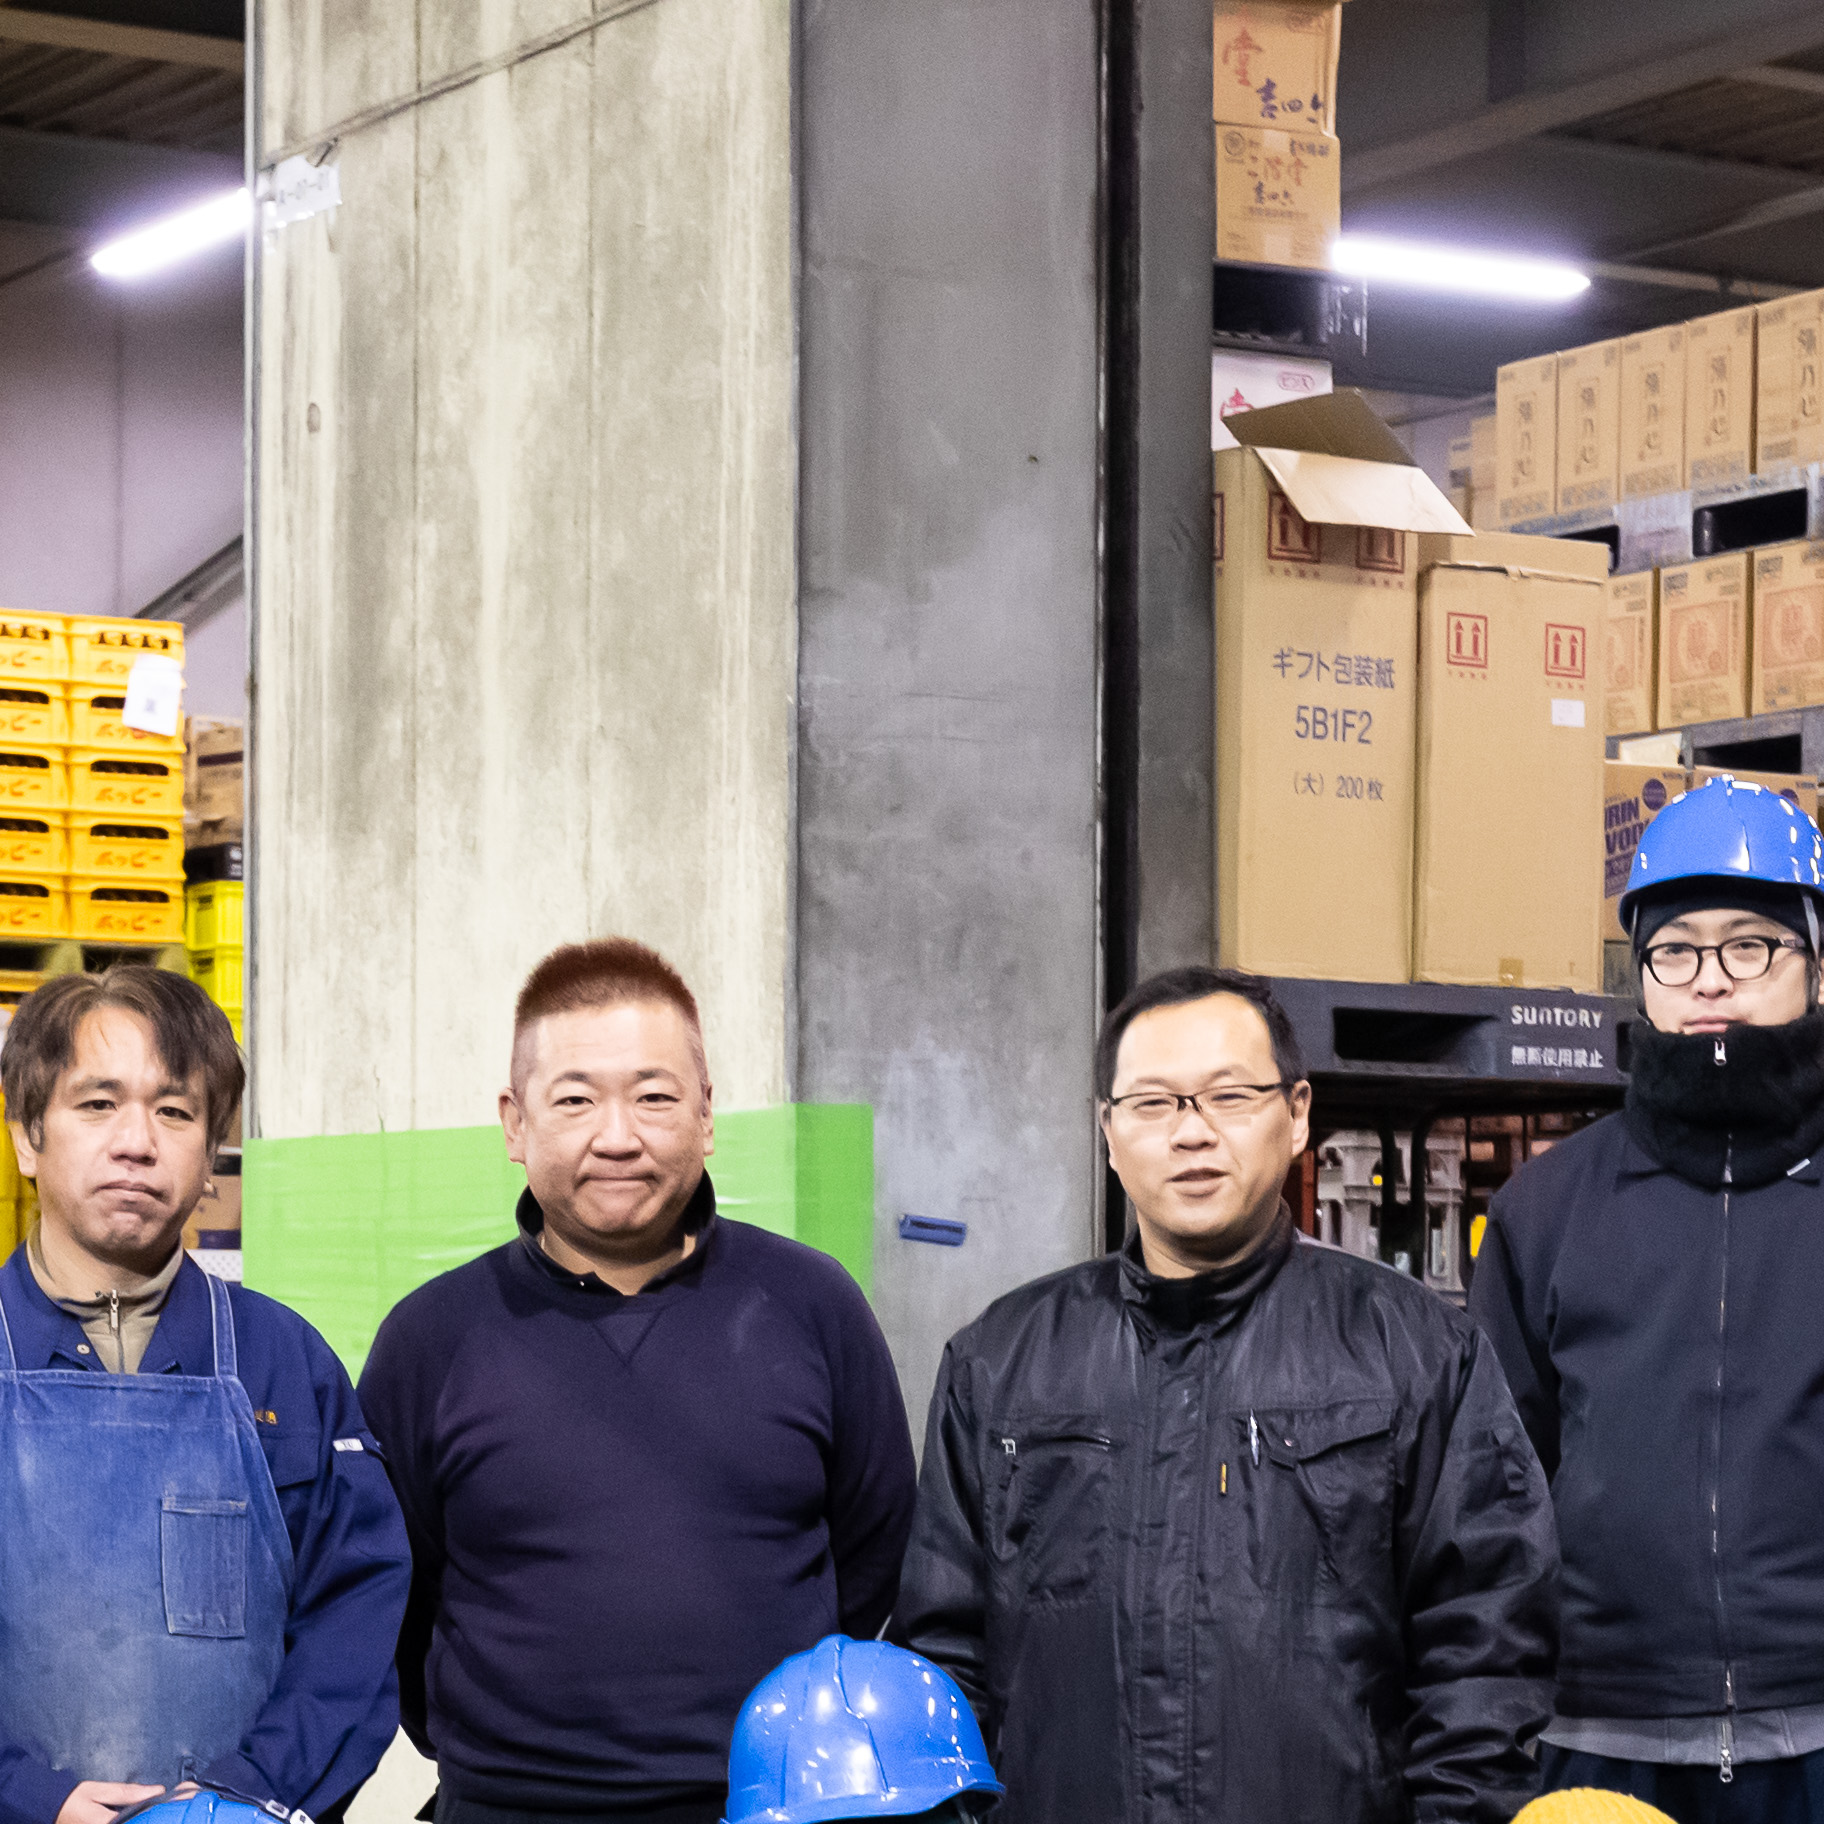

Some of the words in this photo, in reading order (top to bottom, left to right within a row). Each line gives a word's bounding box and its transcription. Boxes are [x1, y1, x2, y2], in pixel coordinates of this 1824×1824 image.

[1273, 647, 1395, 689] ギフト包装紙
[1295, 705, 1373, 744] 5B1F2
[1511, 1005, 1602, 1028] SUNTORY
